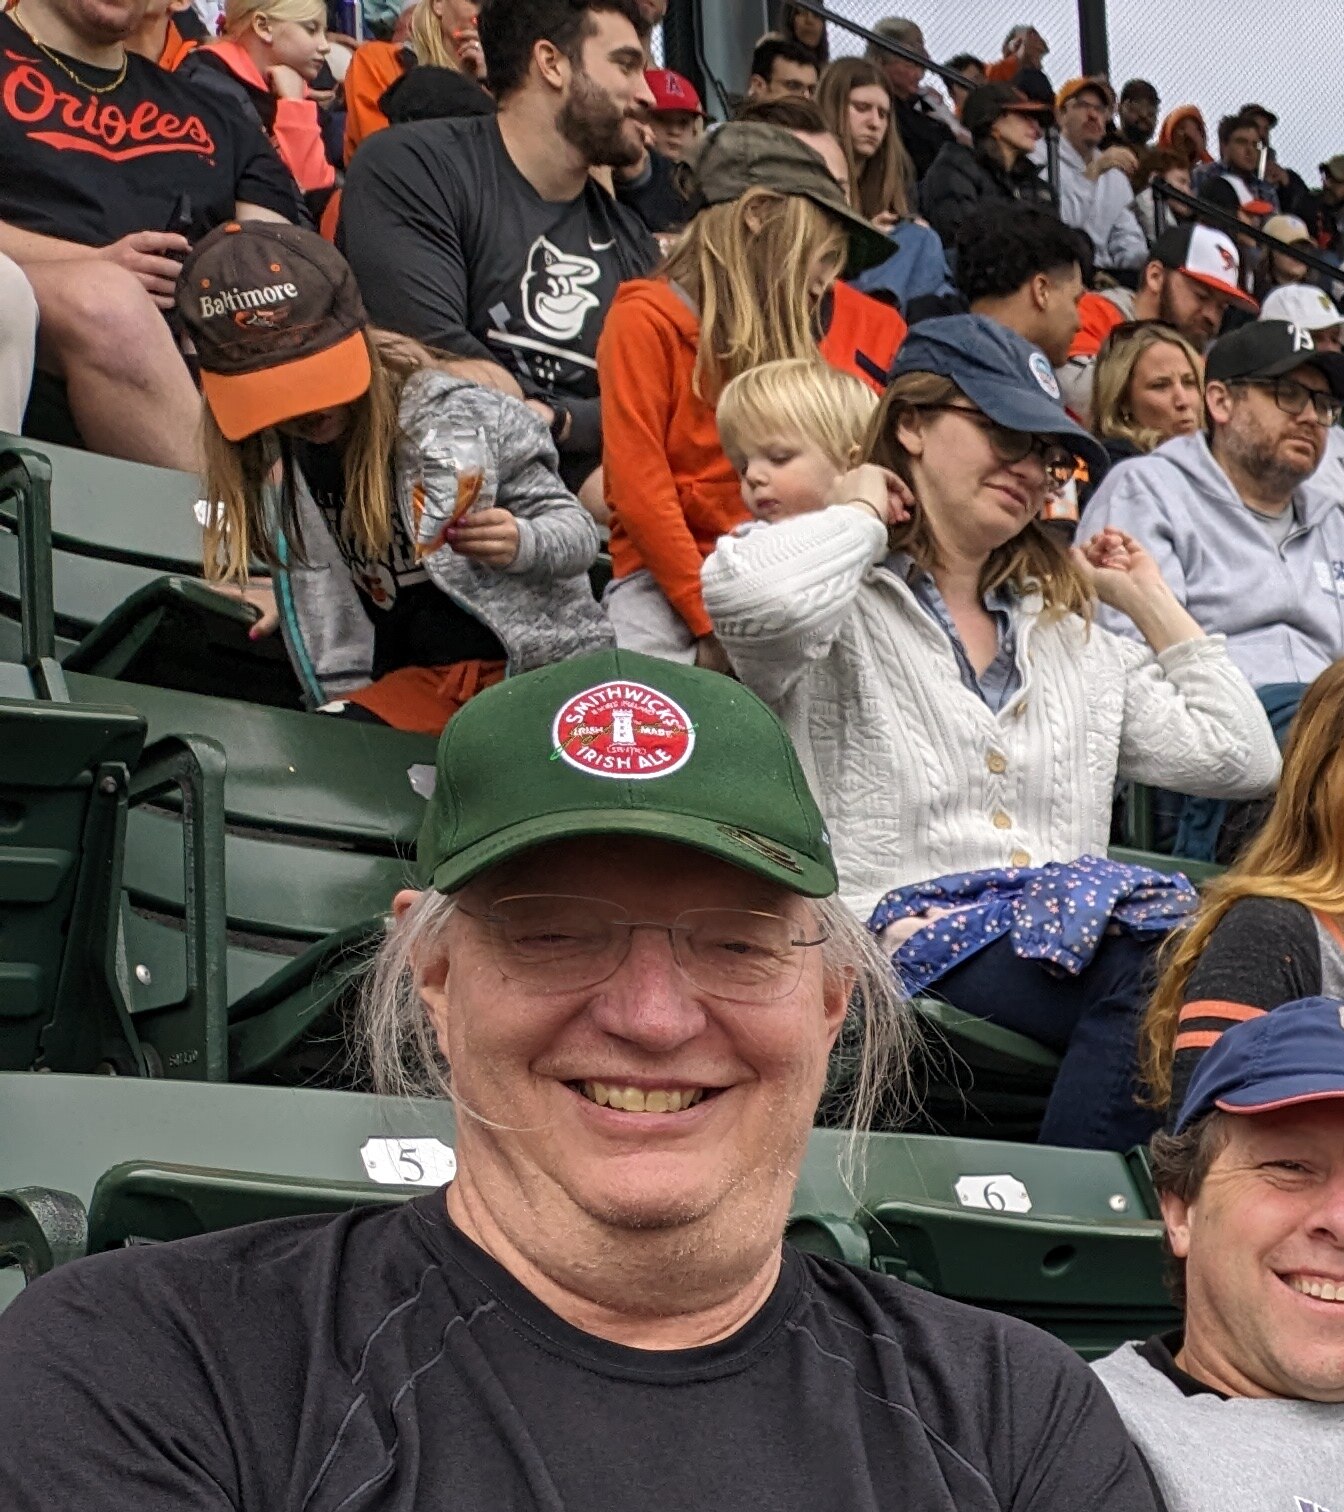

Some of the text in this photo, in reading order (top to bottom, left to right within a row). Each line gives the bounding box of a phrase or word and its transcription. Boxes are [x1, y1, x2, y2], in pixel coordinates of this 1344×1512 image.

[3, 56, 213, 151] Orioles
[200, 282, 298, 318] Baltimore
[576, 746, 631, 769] IRISH
[638, 749, 672, 769] ALE
[399, 1148, 425, 1182] 5
[984, 1181, 1006, 1211] 6
